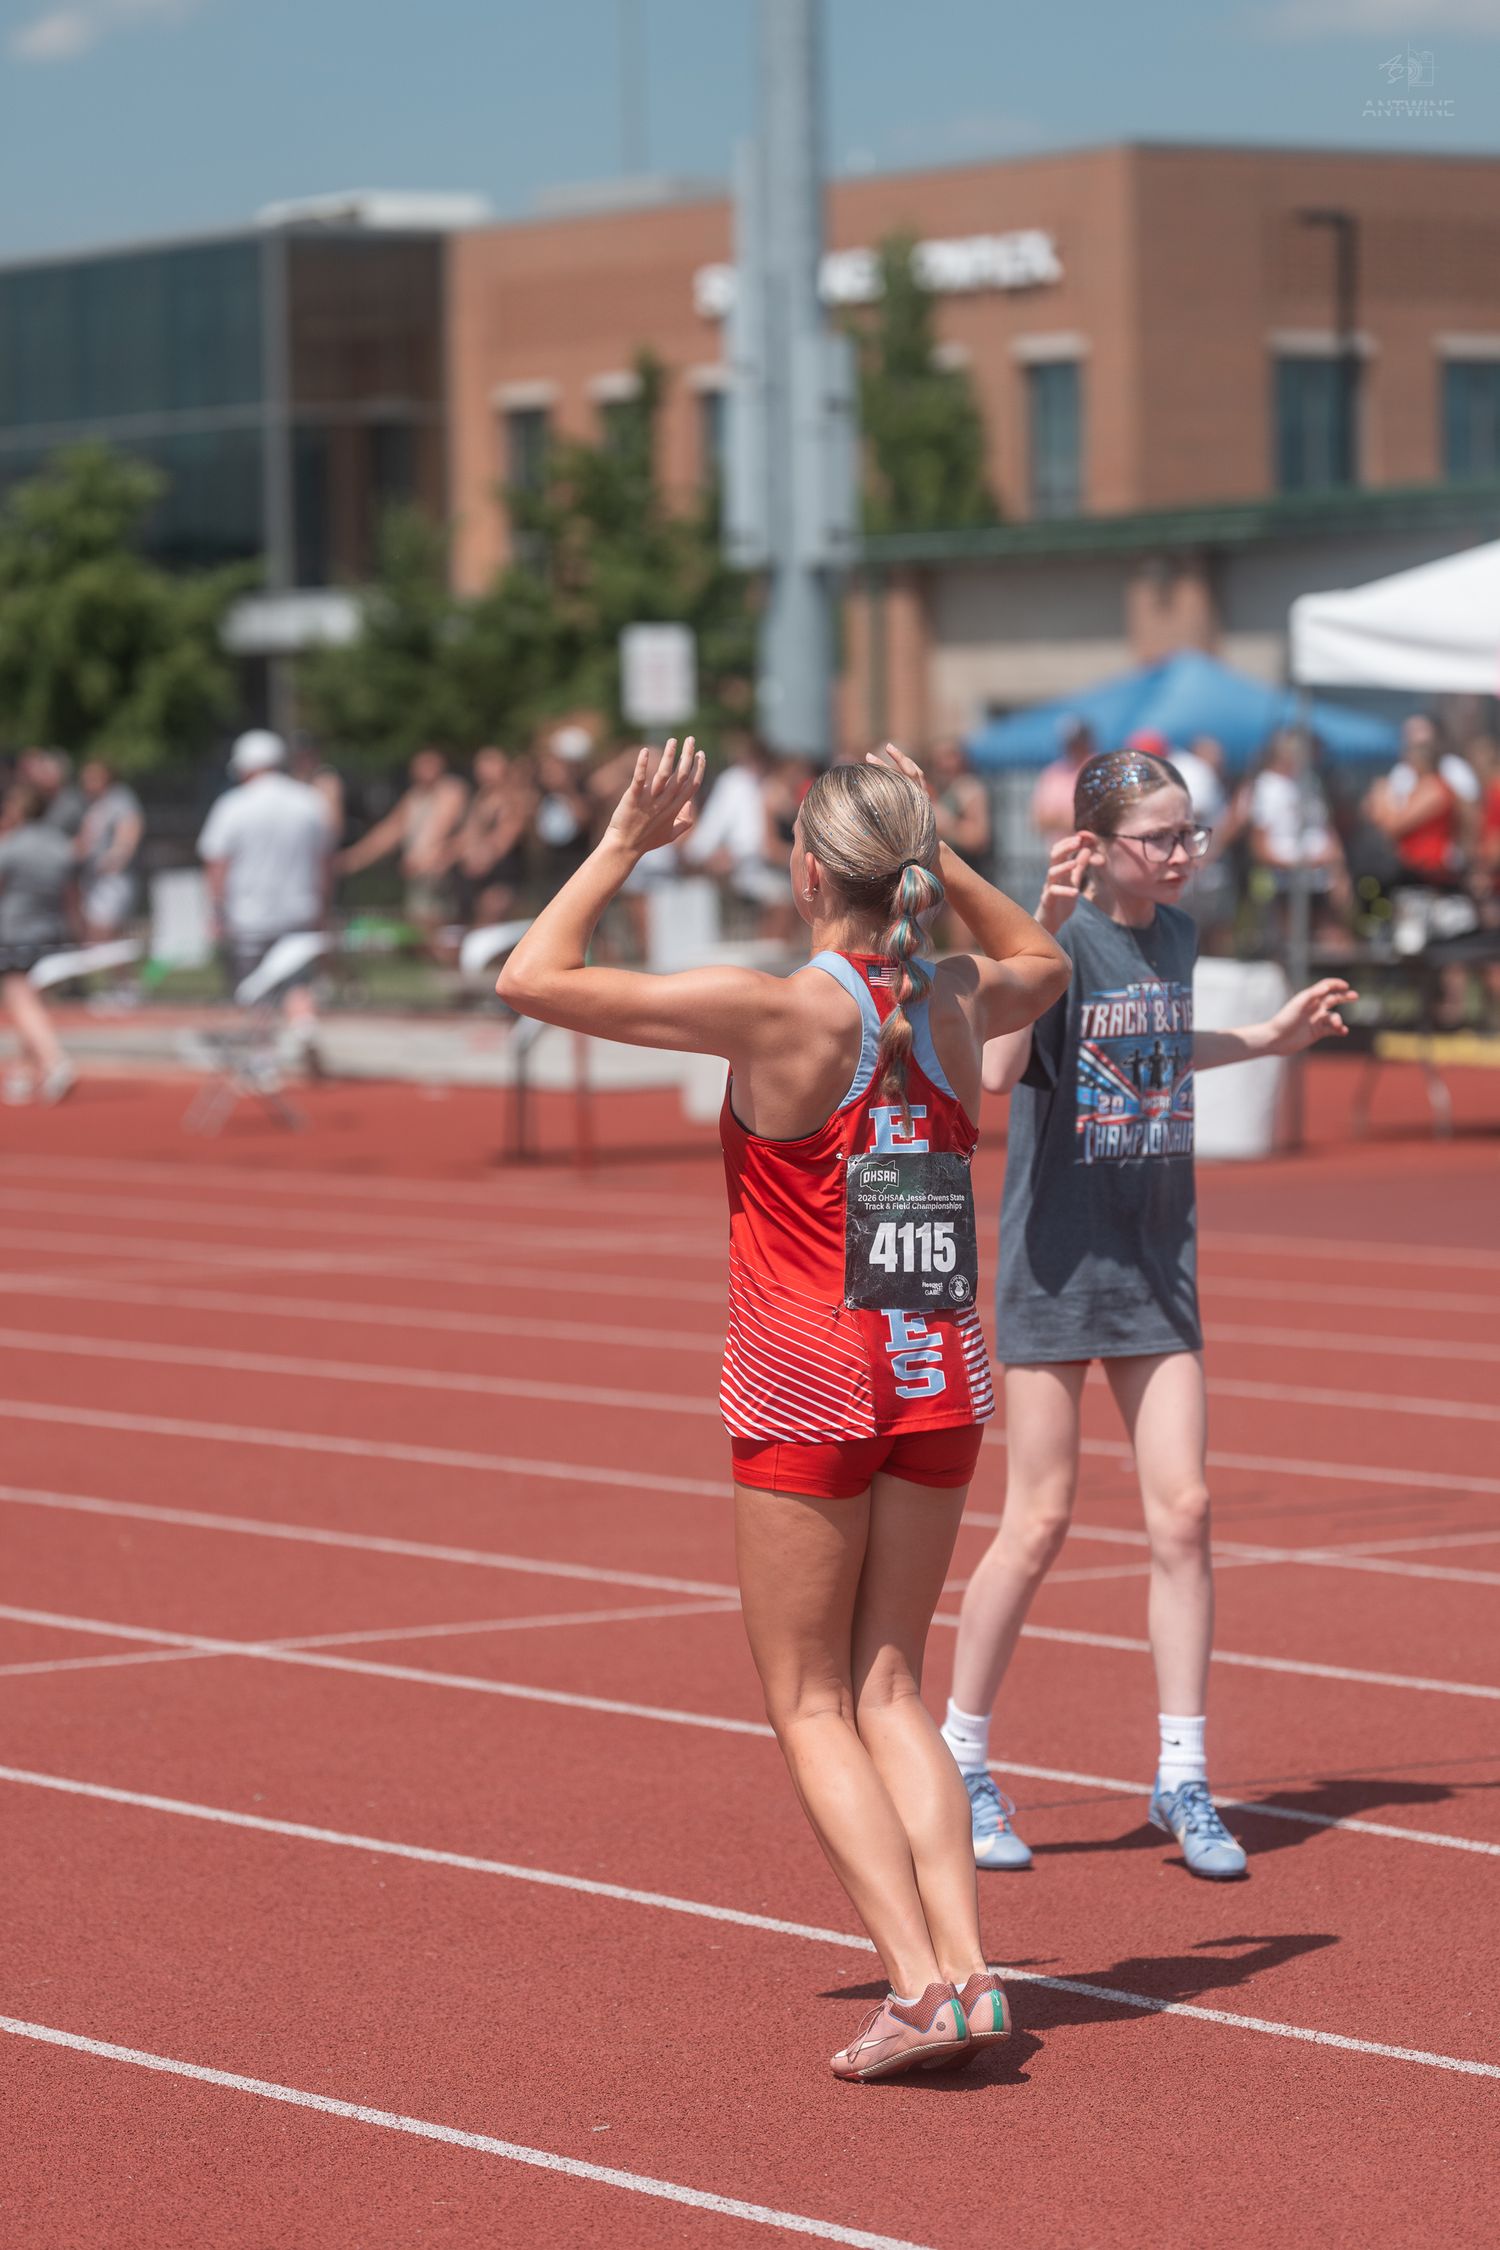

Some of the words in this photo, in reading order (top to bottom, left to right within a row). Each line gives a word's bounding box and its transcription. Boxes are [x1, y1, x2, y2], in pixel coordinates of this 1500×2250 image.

[1081, 1001, 1149, 1038] TRACK
[1153, 999, 1171, 1033] &
[1098, 1094, 1125, 1115] 20
[863, 1170, 898, 1184] OHSAA
[858, 1194, 877, 1202] 2026
[878, 1194, 905, 1202] OHSAA
[906, 1193, 926, 1202] Jesse
[927, 1193, 949, 1202] Owens
[949, 1193, 965, 1202] State
[864, 1202, 884, 1211] Track
[885, 1202, 891, 1210] &
[892, 1202, 911, 1210] Field
[911, 1202, 962, 1212] Championships
[869, 1222, 956, 1273] 4115
